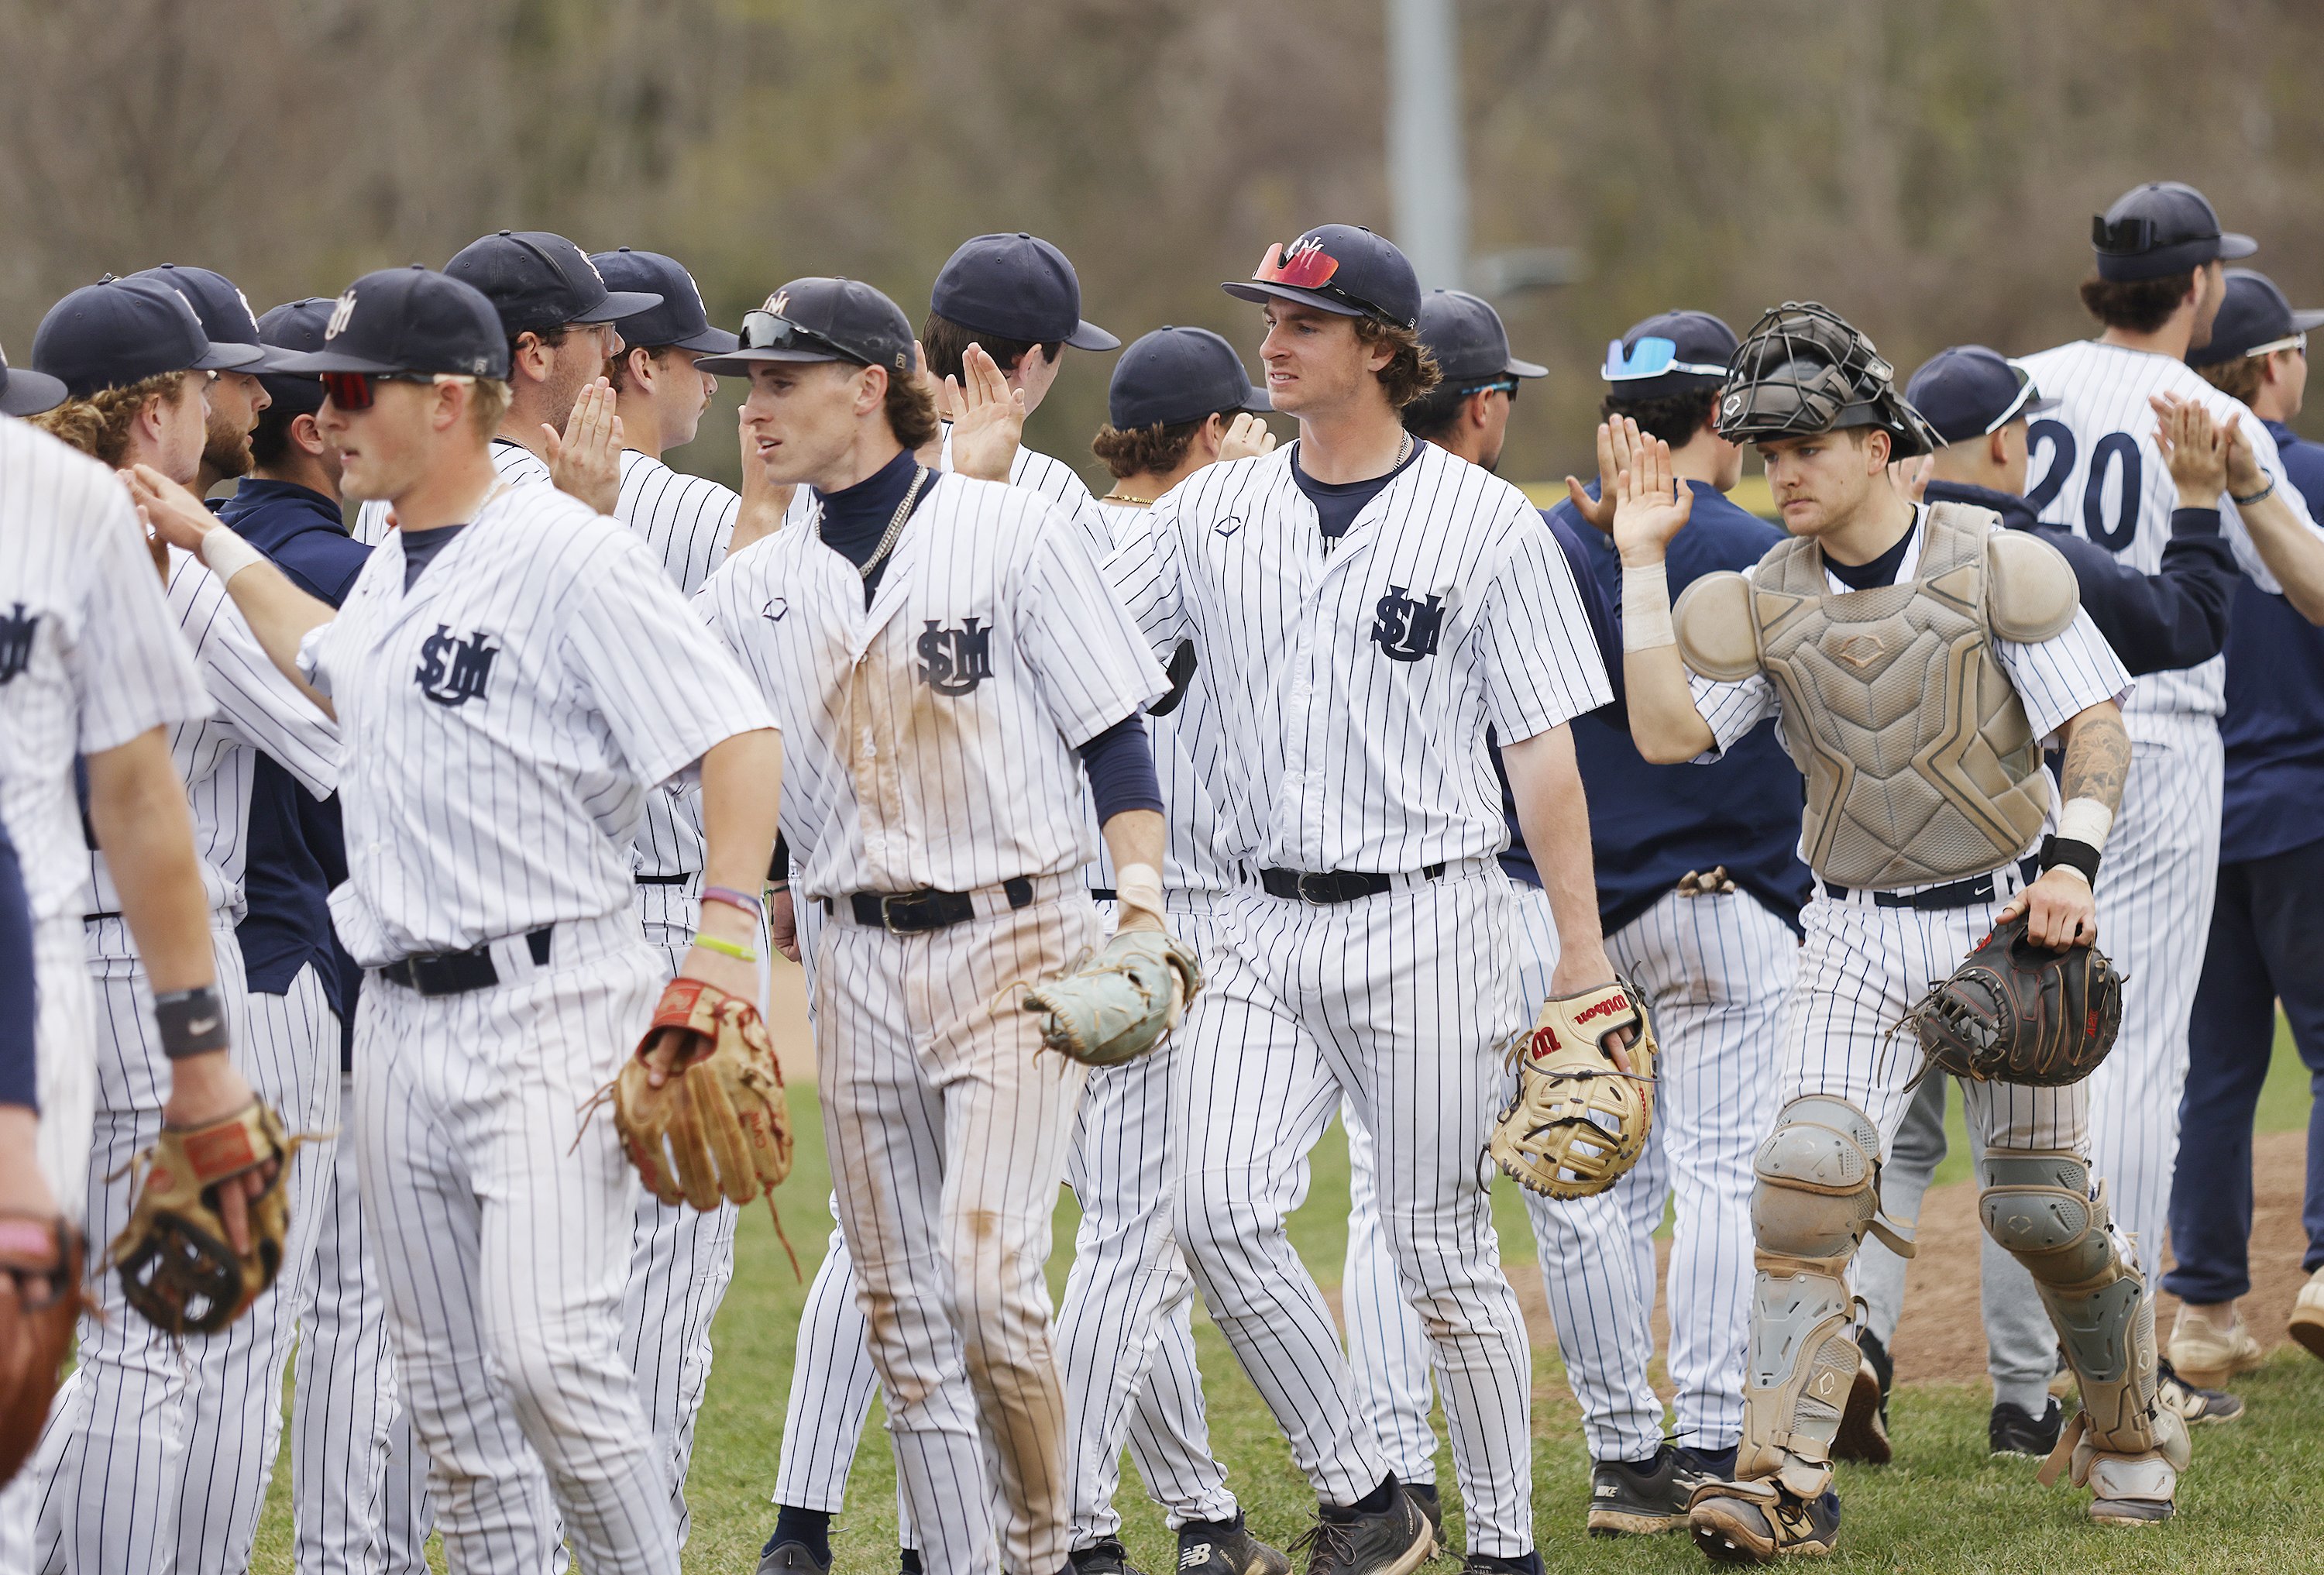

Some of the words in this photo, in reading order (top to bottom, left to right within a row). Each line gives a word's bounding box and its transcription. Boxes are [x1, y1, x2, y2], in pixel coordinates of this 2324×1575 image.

[2023, 419, 2141, 552] 20
[1574, 994, 1629, 1025] Wilson
[1532, 1026, 1563, 1061] W
[1179, 1542, 1212, 1571] NB
